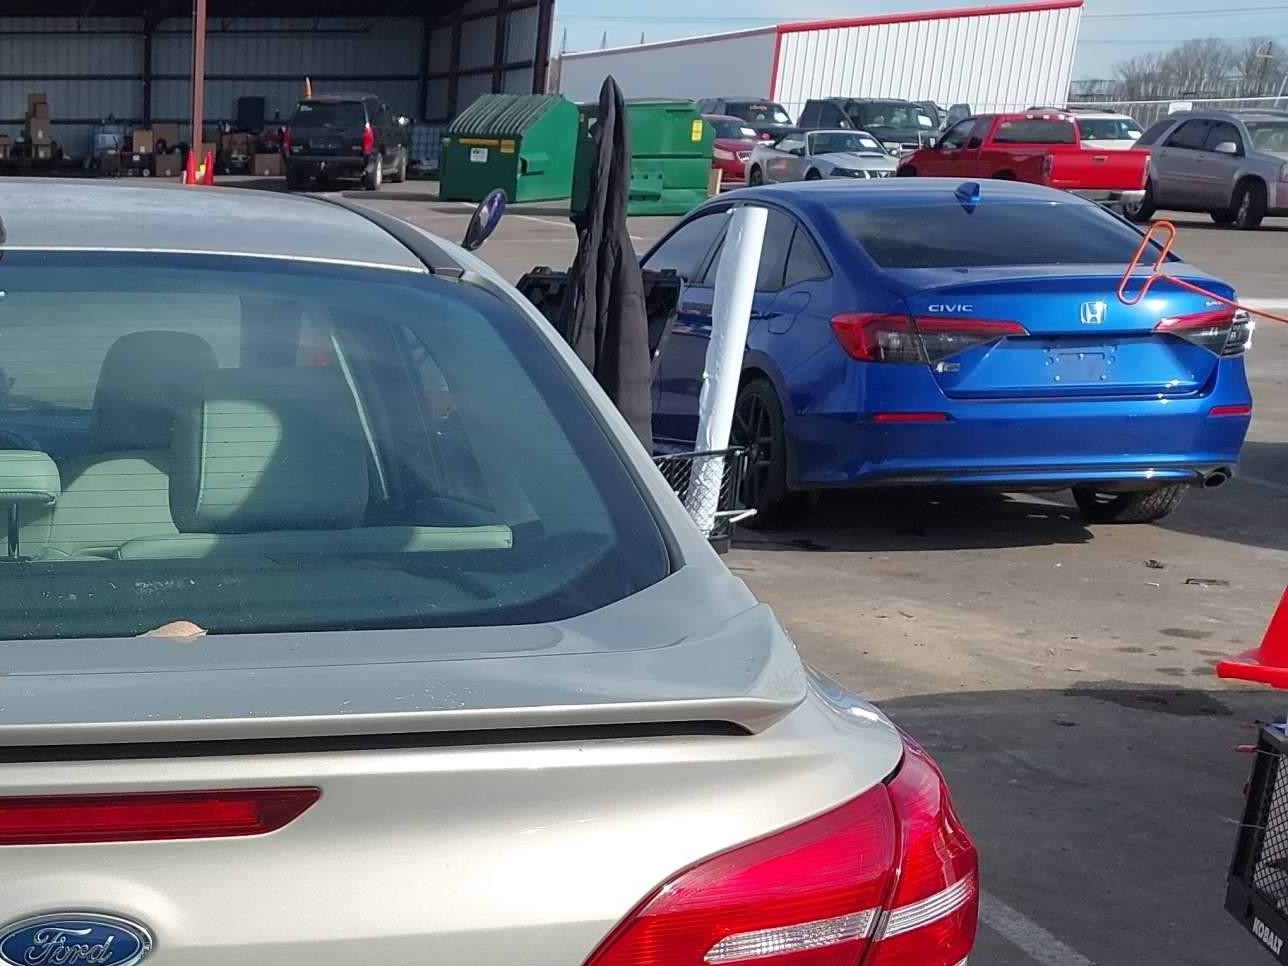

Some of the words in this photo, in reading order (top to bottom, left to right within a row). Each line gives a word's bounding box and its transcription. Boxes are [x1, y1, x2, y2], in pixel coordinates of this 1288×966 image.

[927, 302, 974, 314] CIVIC
[23, 927, 115, 966] Ford
[1252, 915, 1284, 956] KOBALT
